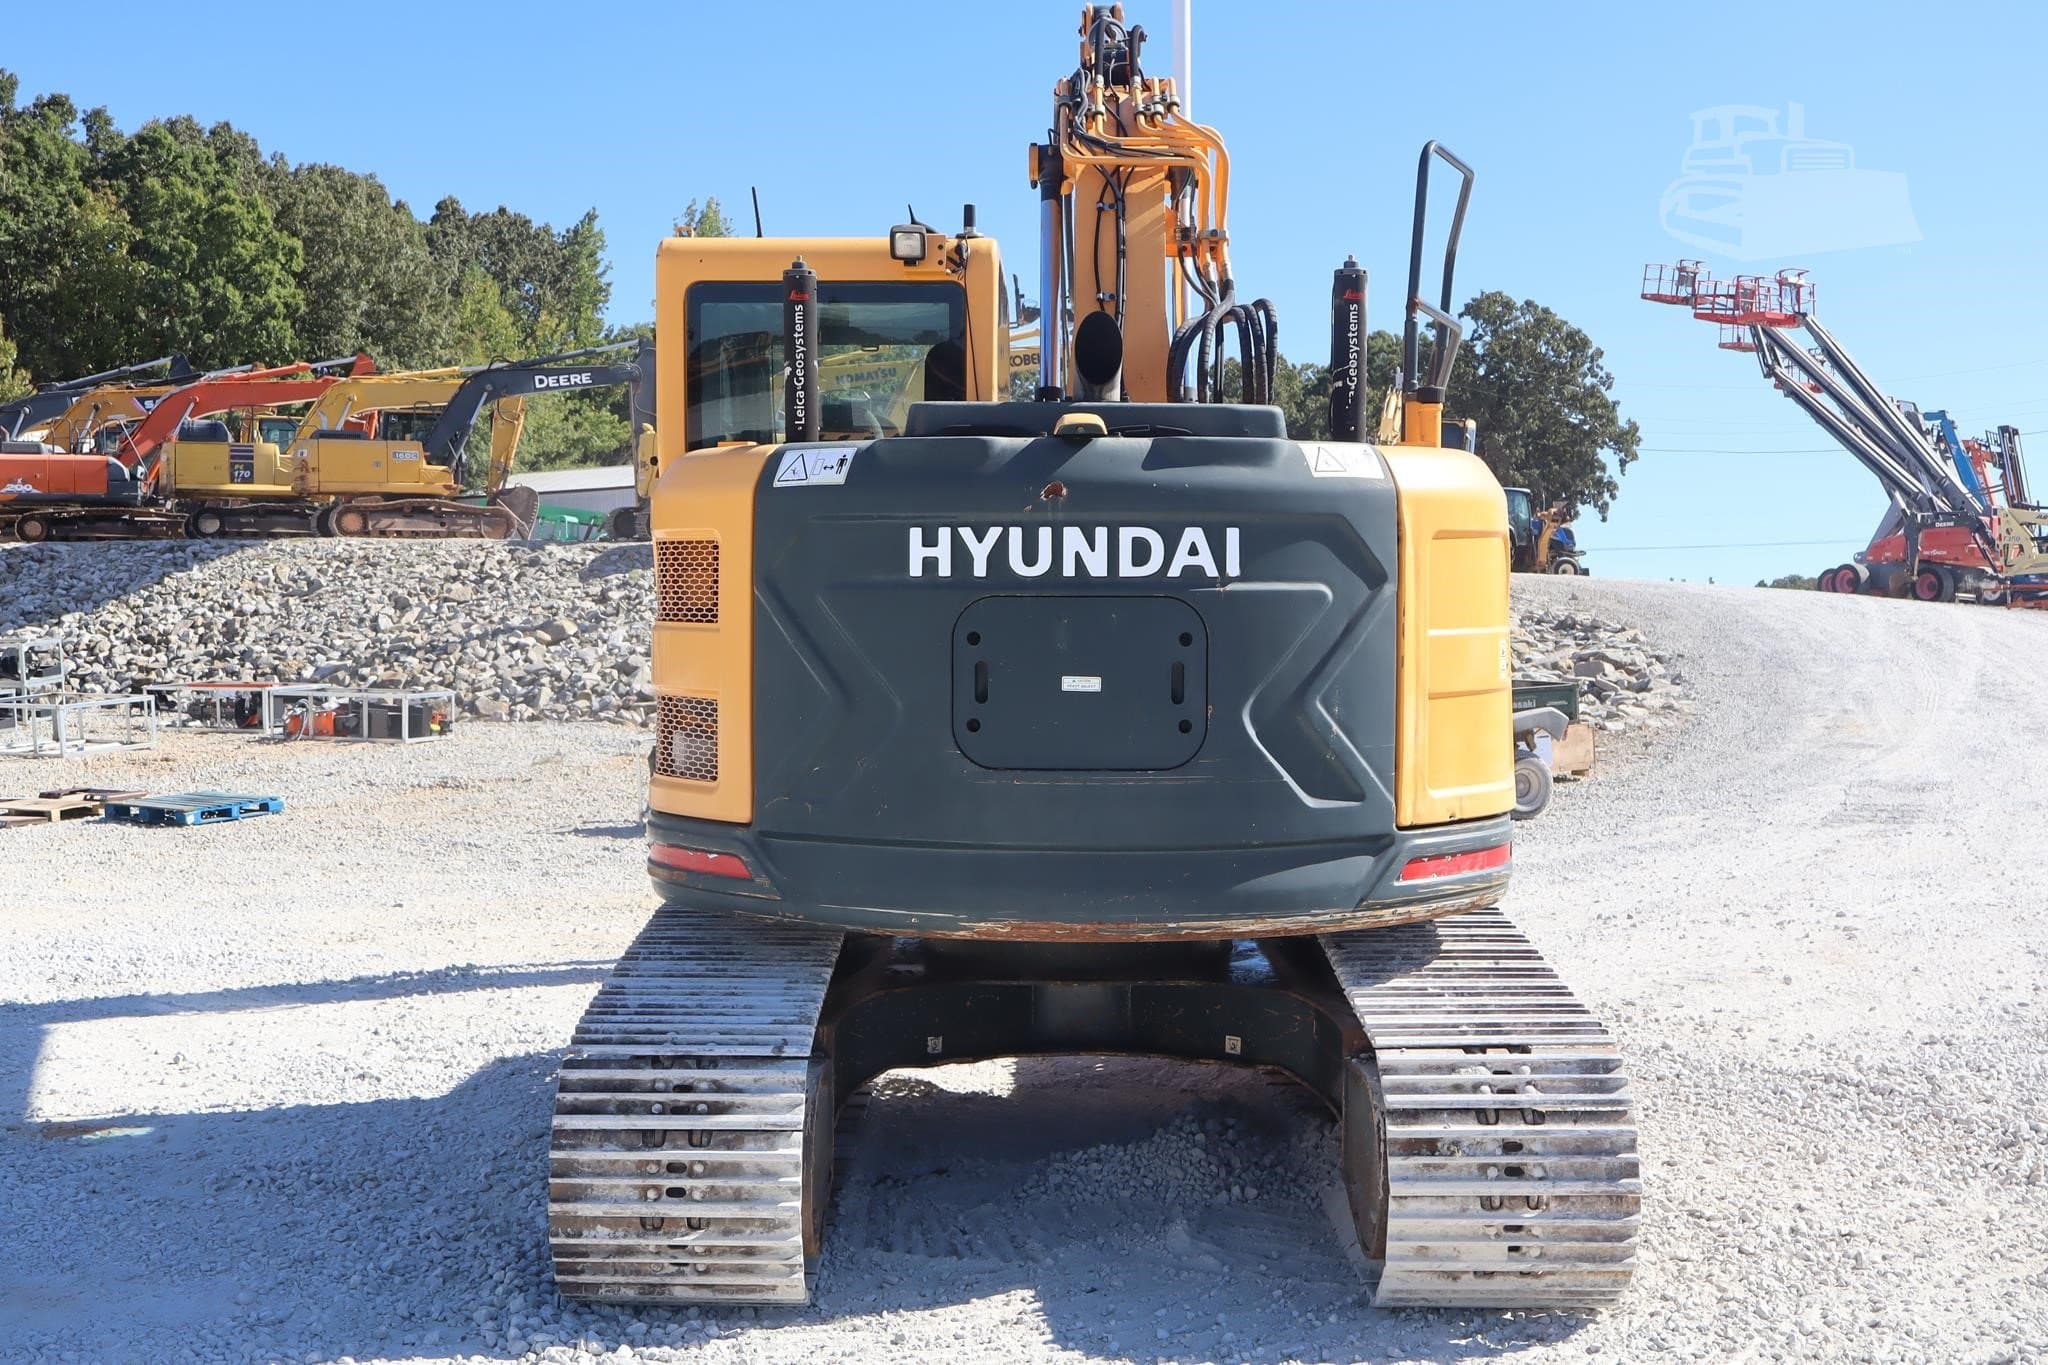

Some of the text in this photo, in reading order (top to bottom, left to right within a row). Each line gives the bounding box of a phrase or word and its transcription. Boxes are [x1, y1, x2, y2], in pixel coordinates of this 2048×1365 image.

[1346, 303, 1360, 386] Geosystems
[534, 372, 592, 388] DEERE
[793, 304, 806, 424] Leica Geosystems
[6, 483, 33, 493] 200
[234, 470, 251, 478] 170
[909, 526, 1240, 577] HYUNDAI
